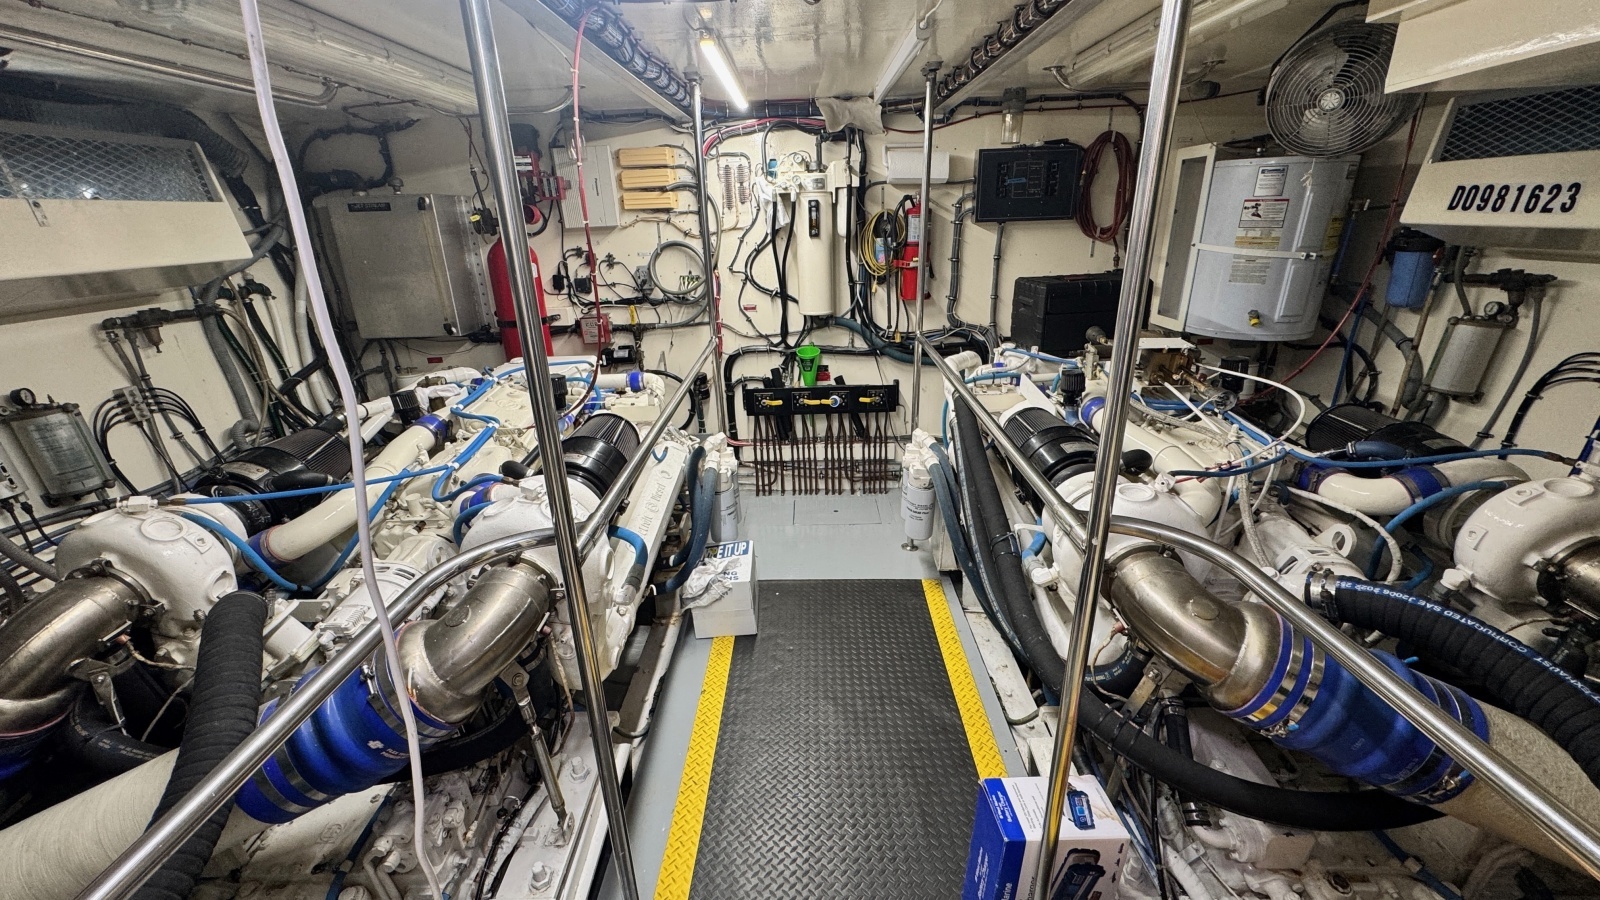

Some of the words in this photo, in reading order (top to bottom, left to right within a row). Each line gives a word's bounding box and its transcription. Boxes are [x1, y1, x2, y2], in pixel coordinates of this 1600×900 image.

[724, 544, 734, 557] IT
[734, 542, 747, 555] UP
[1382, 589, 1416, 604] J2006
[1417, 599, 1443, 612] SAE
[1444, 609, 1528, 653] CORRUGATED
[1534, 655, 1591, 694] EXHAUST
